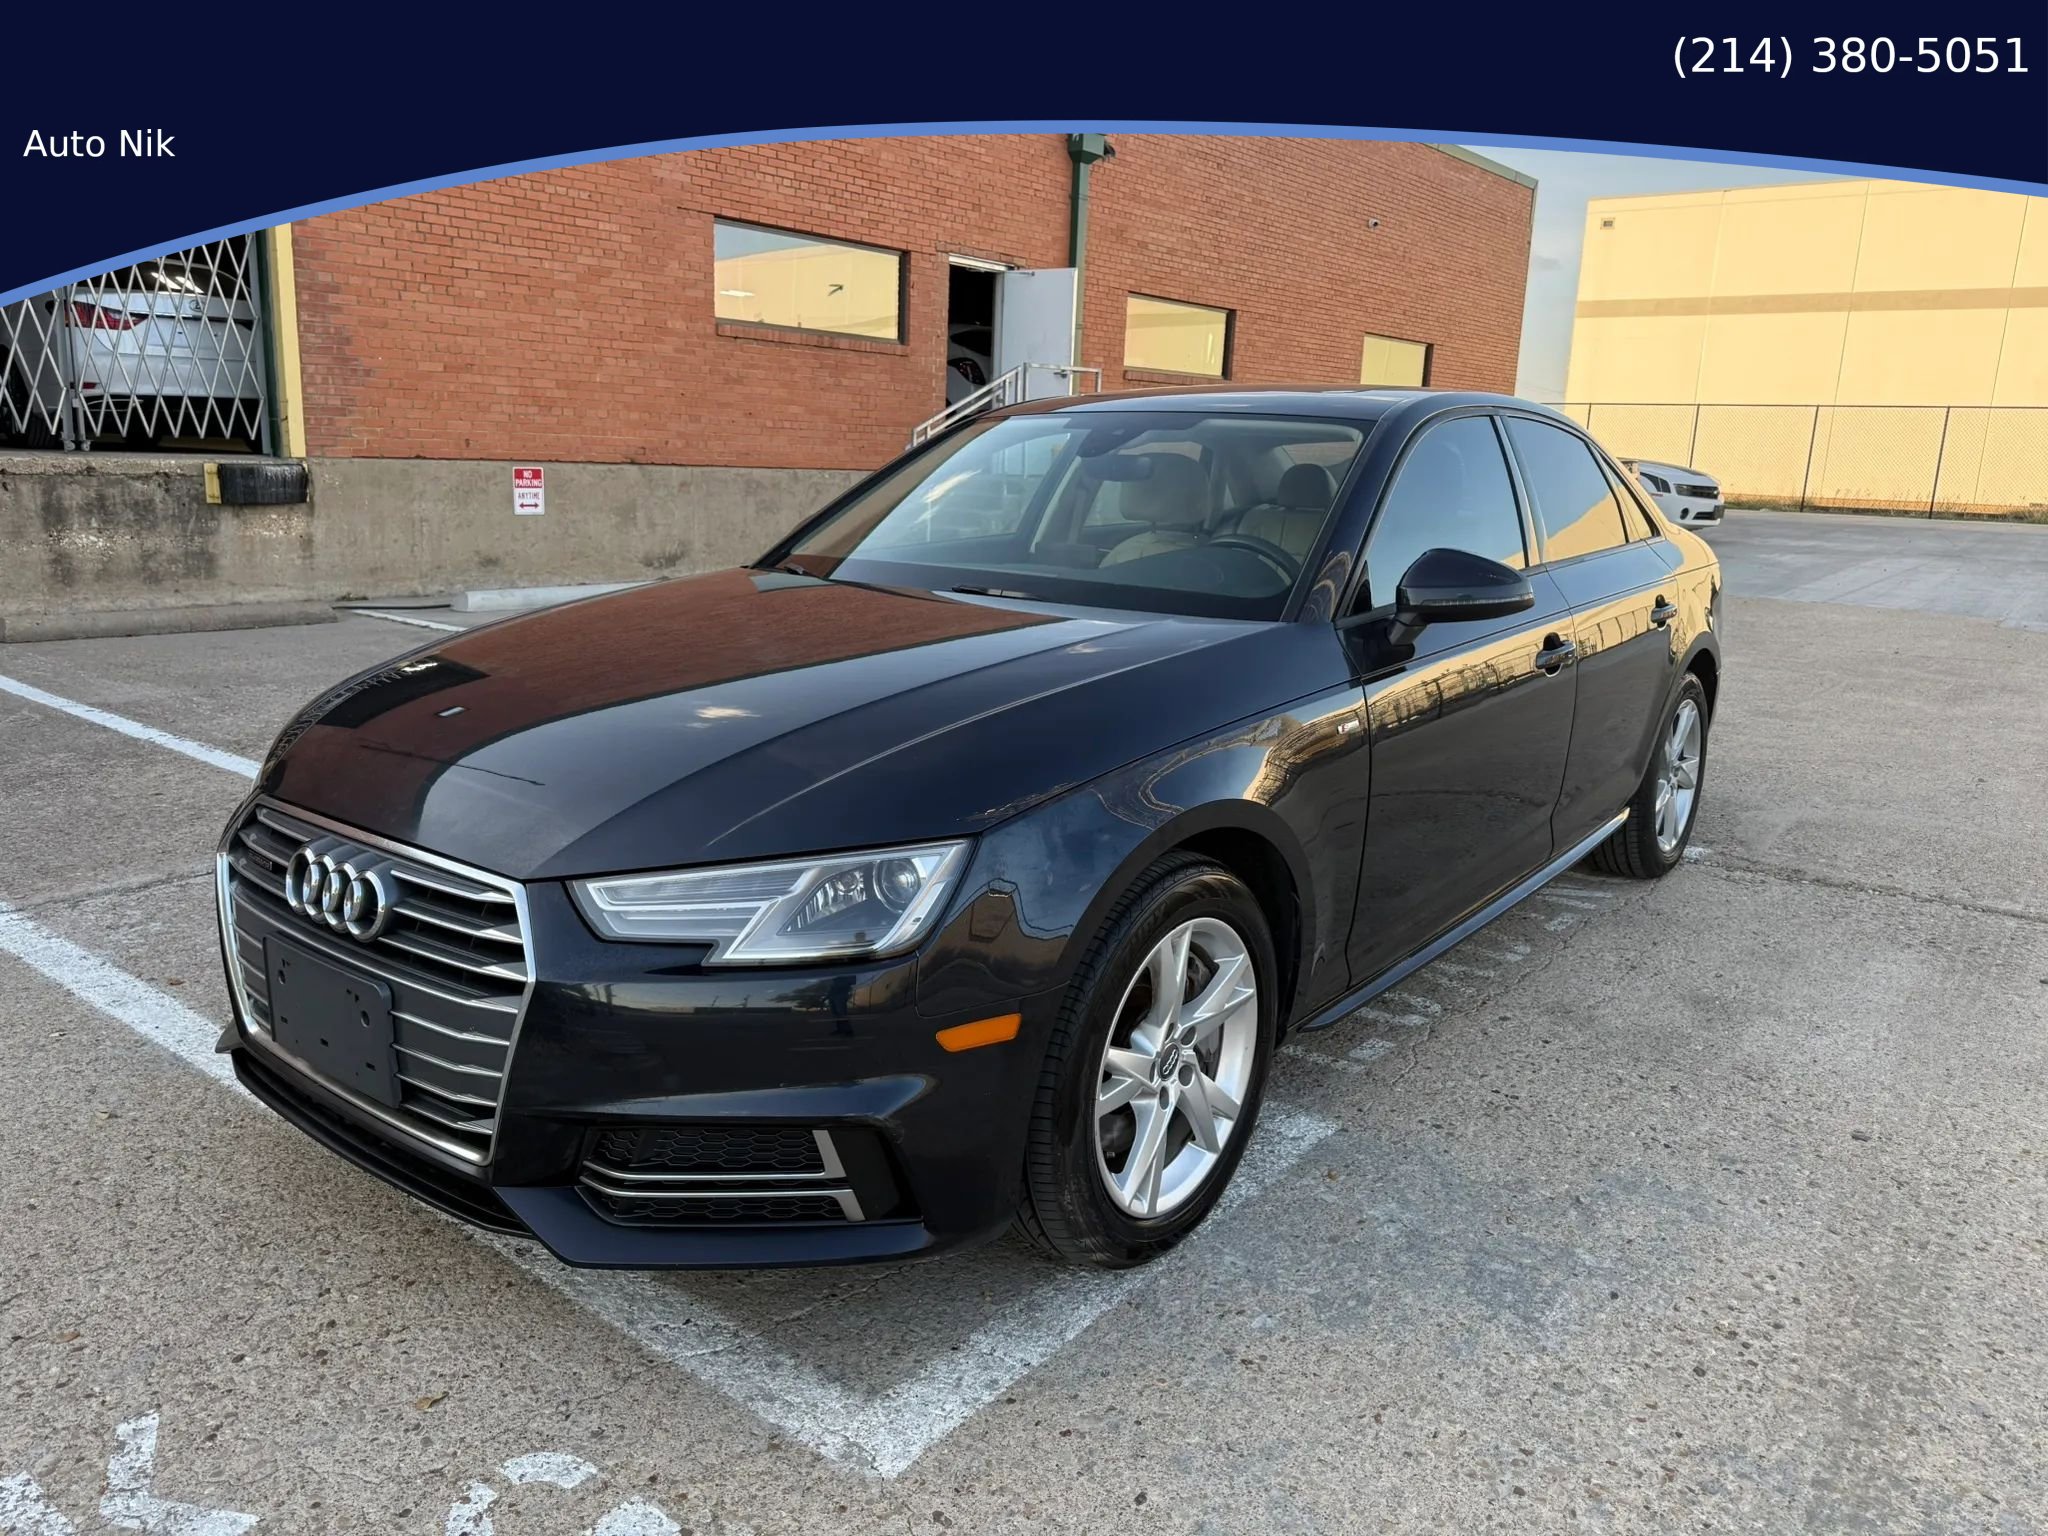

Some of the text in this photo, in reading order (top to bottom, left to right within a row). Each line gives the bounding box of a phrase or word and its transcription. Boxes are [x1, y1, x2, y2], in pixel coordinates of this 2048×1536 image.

[523, 470, 533, 478] NO
[516, 478, 543, 487] PARKING
[518, 492, 540, 500] ANYTIME
